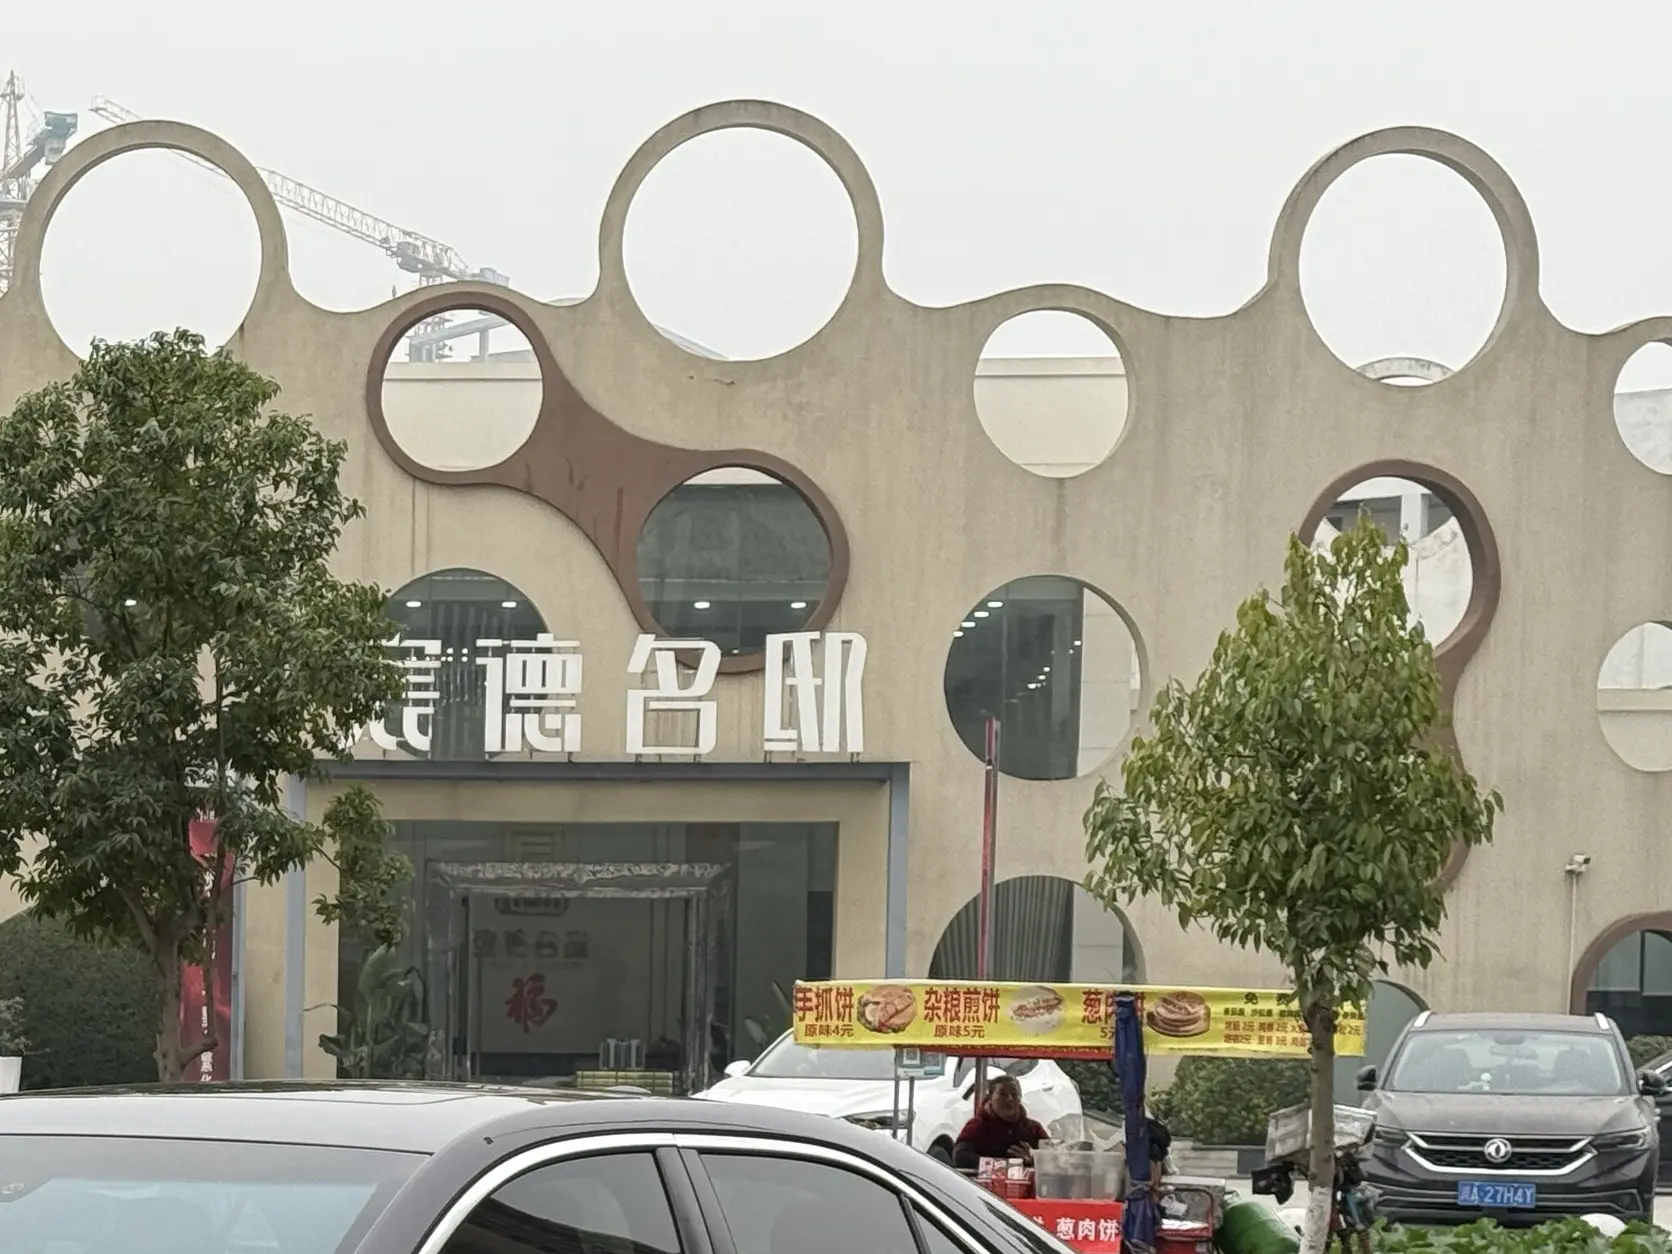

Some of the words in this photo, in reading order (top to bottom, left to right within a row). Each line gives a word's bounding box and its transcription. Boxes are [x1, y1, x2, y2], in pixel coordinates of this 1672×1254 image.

[794, 986, 854, 1023] 手抓饼
[923, 986, 1001, 1024] 杂粮煎饼
[804, 1024, 855, 1037] 原味4元
[934, 1025, 985, 1039] 原味5元
[1056, 1216, 1119, 1242] 葱肉饼
